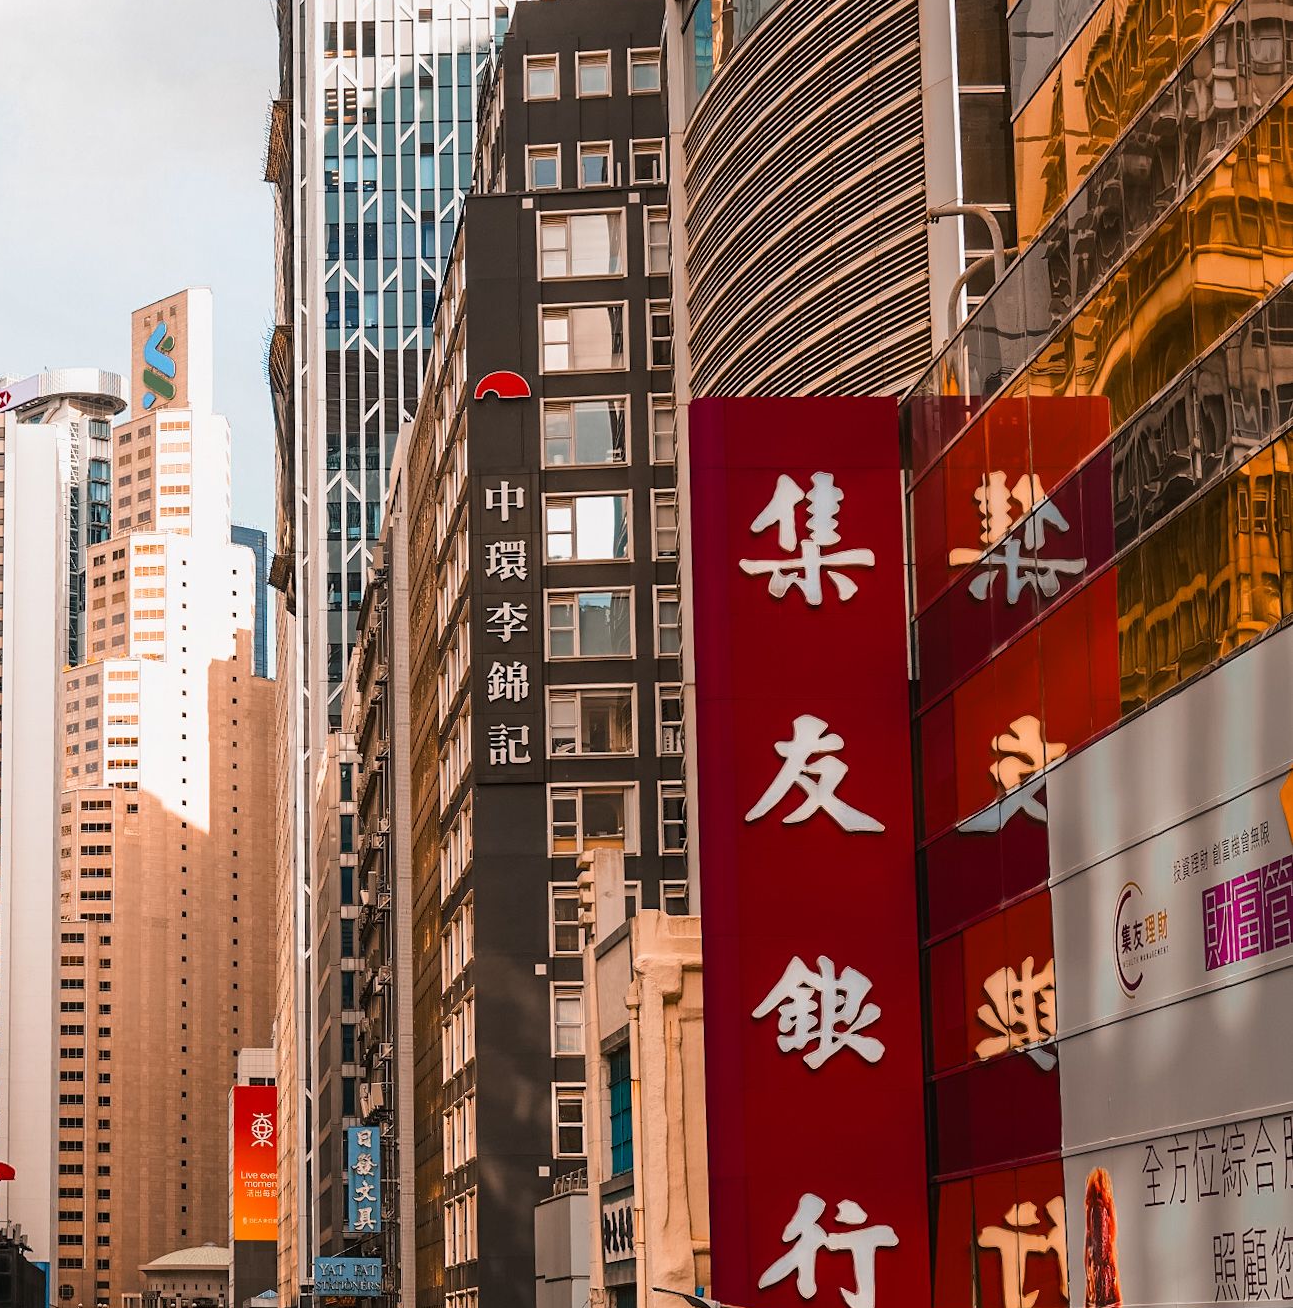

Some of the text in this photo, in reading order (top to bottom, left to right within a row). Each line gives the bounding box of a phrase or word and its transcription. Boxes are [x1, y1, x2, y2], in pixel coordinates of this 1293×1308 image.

[485, 481, 531, 766] 中環李錦記
[1121, 909, 1168, 955] 集友理財
[240, 1171, 257, 1179] Live
[352, 1129, 377, 1230] 日發文具
[318, 1263, 379, 1277] YAT FAT
[315, 1280, 381, 1292] STATIONERS
